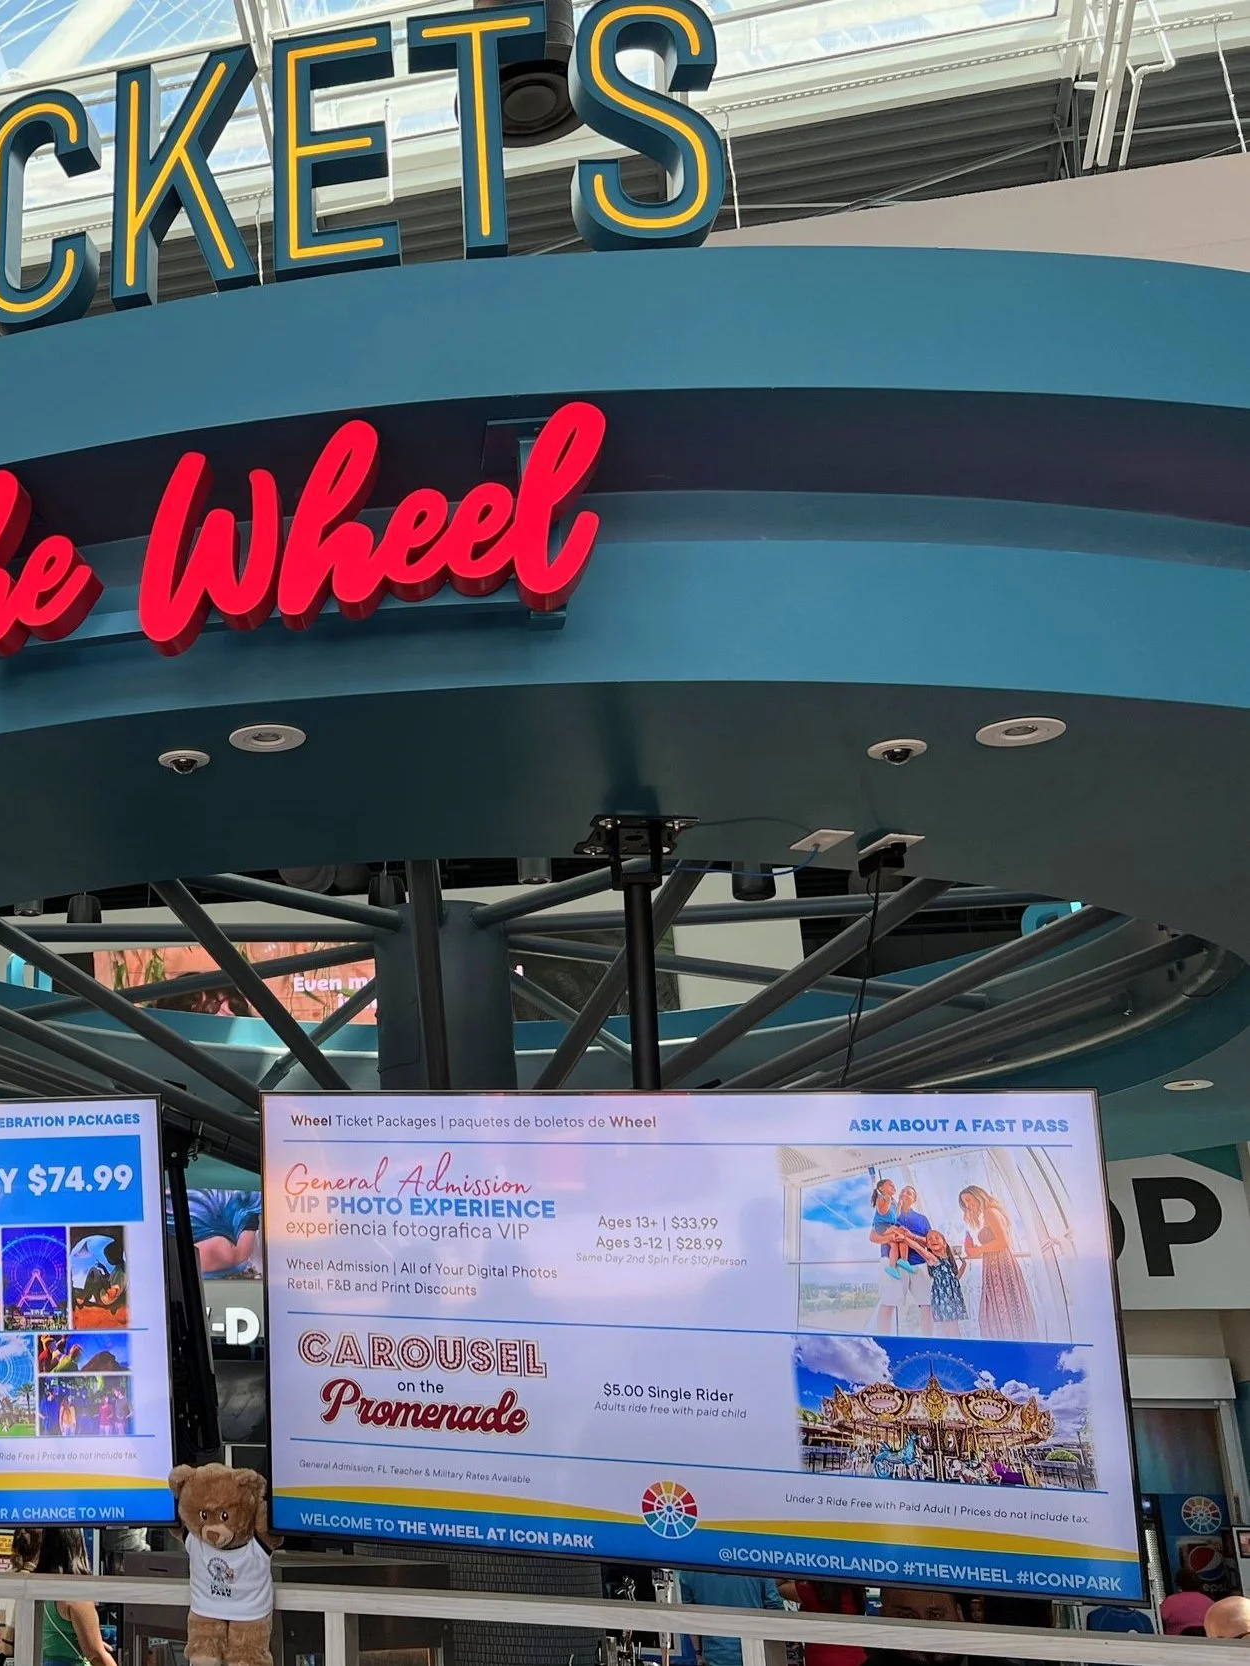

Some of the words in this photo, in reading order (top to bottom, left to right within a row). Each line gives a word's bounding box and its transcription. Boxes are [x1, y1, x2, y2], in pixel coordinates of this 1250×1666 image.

[137, 401, 607, 658] Wheel
[293, 976, 343, 992] Even
[67, 1113, 140, 1127] PACKAGES
[291, 1115, 332, 1127] Wheel
[335, 1115, 373, 1127] Ticket
[376, 1115, 436, 1130] Packages
[449, 1116, 510, 1131] paquetes
[513, 1116, 531, 1127] de
[535, 1116, 584, 1128] boletos
[588, 1116, 605, 1128] de
[609, 1116, 657, 1128] Wheel
[849, 1119, 884, 1132] ASK
[887, 1119, 950, 1132] ABOUT
[955, 1119, 968, 1132] A
[972, 1119, 1017, 1133] FAST
[1022, 1119, 1069, 1133] PASS
[27, 1163, 133, 1197] $74.99
[284, 1155, 390, 1196] General
[396, 1151, 532, 1198] Admission
[285, 1195, 320, 1214] VIP
[326, 1196, 403, 1215] PHOTO
[410, 1198, 556, 1219] EXPERIENCE
[286, 1219, 387, 1239] experiencia
[392, 1219, 492, 1242] fotografica
[497, 1223, 530, 1240] VIP
[598, 1216, 632, 1230] Ages
[636, 1216, 658, 1229] 13+
[671, 1216, 718, 1230] $33.99
[596, 1236, 630, 1250] Ages
[633, 1237, 663, 1249] 3-12
[676, 1237, 723, 1250] $28.99
[286, 1259, 324, 1272] Wheel
[327, 1260, 389, 1274] Admission
[400, 1262, 416, 1274] All
[419, 1262, 432, 1275] of
[435, 1263, 463, 1276] Your
[467, 1264, 508, 1279] Digital
[512, 1265, 558, 1279] Photos
[287, 1278, 324, 1292] Retail,
[327, 1279, 351, 1292] F&B
[355, 1280, 378, 1293] and
[381, 1281, 410, 1294] Print
[414, 1283, 477, 1296] Discounts
[298, 1329, 547, 1378] CAROUSEL
[397, 1381, 416, 1393] on
[420, 1379, 444, 1394] the
[603, 1382, 644, 1397] $5.00
[648, 1385, 692, 1402] Single
[696, 1387, 734, 1403] Rider
[319, 1376, 530, 1436] Promenade
[594, 1401, 626, 1413] Adults
[628, 1403, 647, 1413] ride
[650, 1403, 670, 1414] free
[672, 1405, 694, 1416] with
[696, 1406, 719, 1418] paid
[721, 1407, 747, 1419] child
[11, 1508, 20, 1519] A
[22, 1507, 76, 1520] CHANCE
[79, 1507, 96, 1519] TO
[98, 1506, 125, 1519] WIN
[785, 1493, 815, 1505] Under
[817, 1495, 824, 1506] 3
[826, 1496, 848, 1508] Ride
[850, 1498, 872, 1509] Free
[875, 1500, 897, 1511] with
[899, 1501, 921, 1513] Paid
[923, 1502, 951, 1515] Adult
[960, 1505, 991, 1517] Prices
[994, 1507, 1007, 1519] do
[1010, 1509, 1028, 1520] not
[1030, 1510, 1069, 1523] include
[300, 1512, 372, 1532] WELCOME
[375, 1517, 395, 1532] TO
[397, 1519, 427, 1536] THE
[429, 1522, 484, 1541] WHEEL
[486, 1527, 506, 1542] AT
[509, 1529, 549, 1545] ICON
[552, 1532, 594, 1549] PARK
[718, 1547, 899, 1574] @ICONPARKORLANDO
[902, 1561, 1013, 1585] #THEWHEEL
[1016, 1569, 1122, 1593] #ICONPARK
